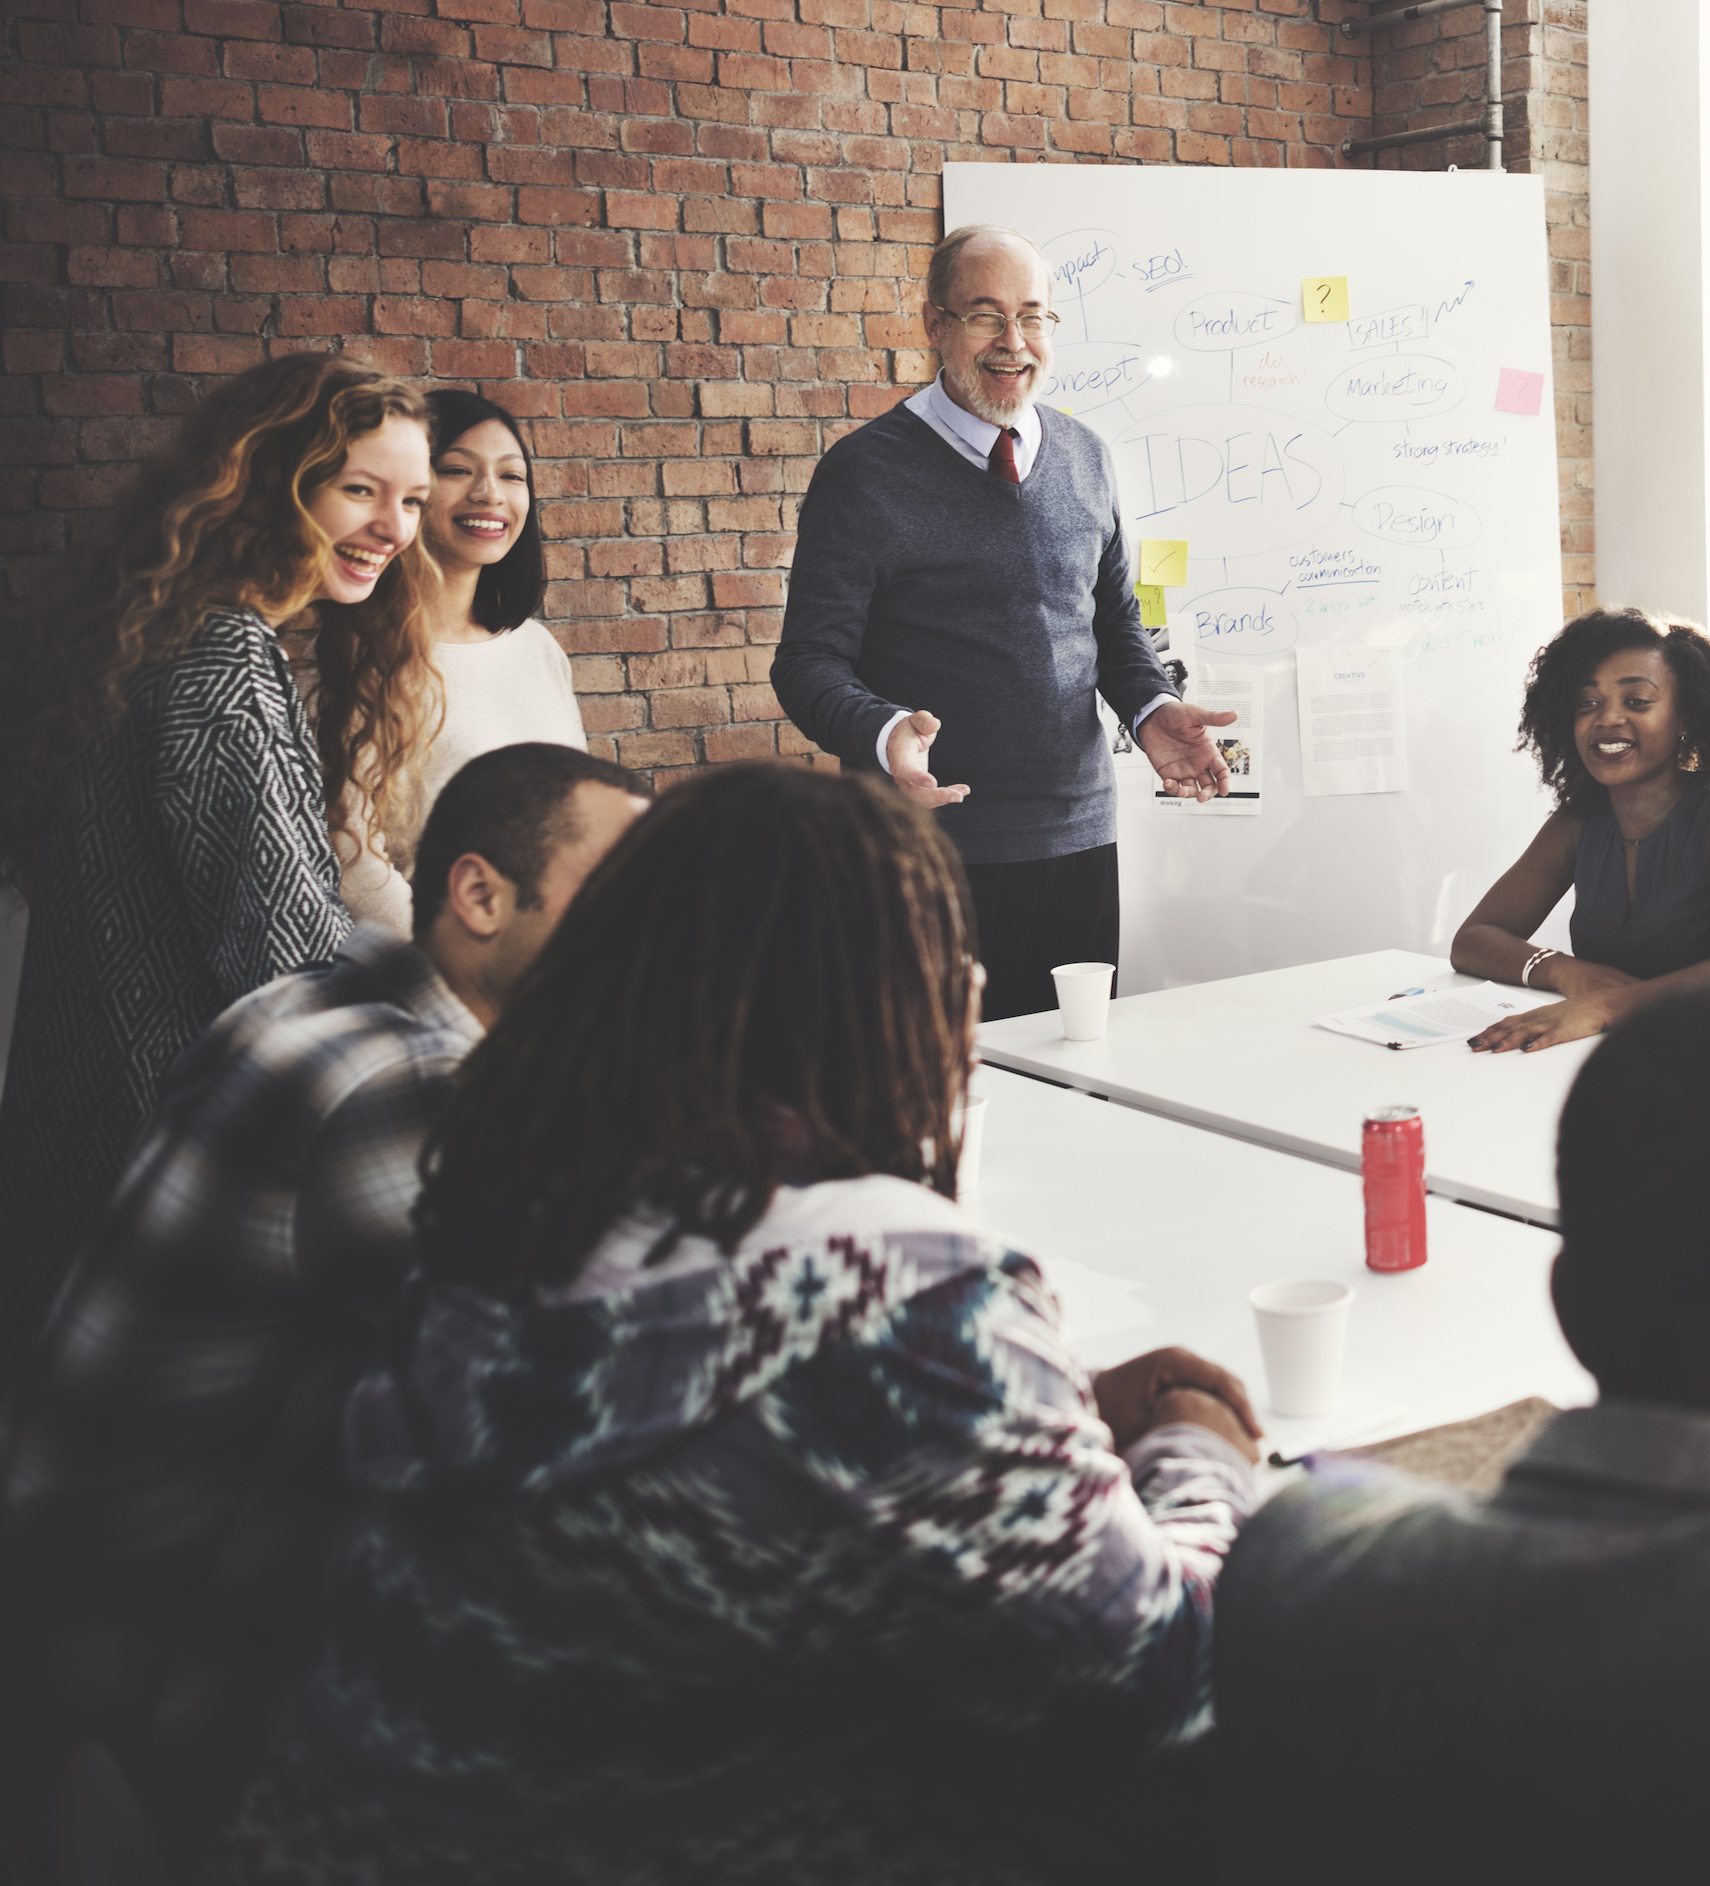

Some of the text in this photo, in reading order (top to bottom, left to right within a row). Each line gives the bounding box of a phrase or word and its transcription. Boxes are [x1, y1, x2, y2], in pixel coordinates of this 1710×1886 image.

[1132, 248, 1189, 281] SEO!
[1316, 284, 1332, 314] ?
[1190, 307, 1279, 337] Product
[1042, 355, 1138, 396] oncept
[1346, 369, 1449, 406] Marketing
[1393, 438, 1440, 466] strong
[1123, 431, 1322, 520] IDEAS
[1372, 502, 1456, 543] Design
[1407, 566, 1480, 596] content
[1196, 603, 1275, 638] Brands
[1333, 672, 1367, 681] CREATIVE
